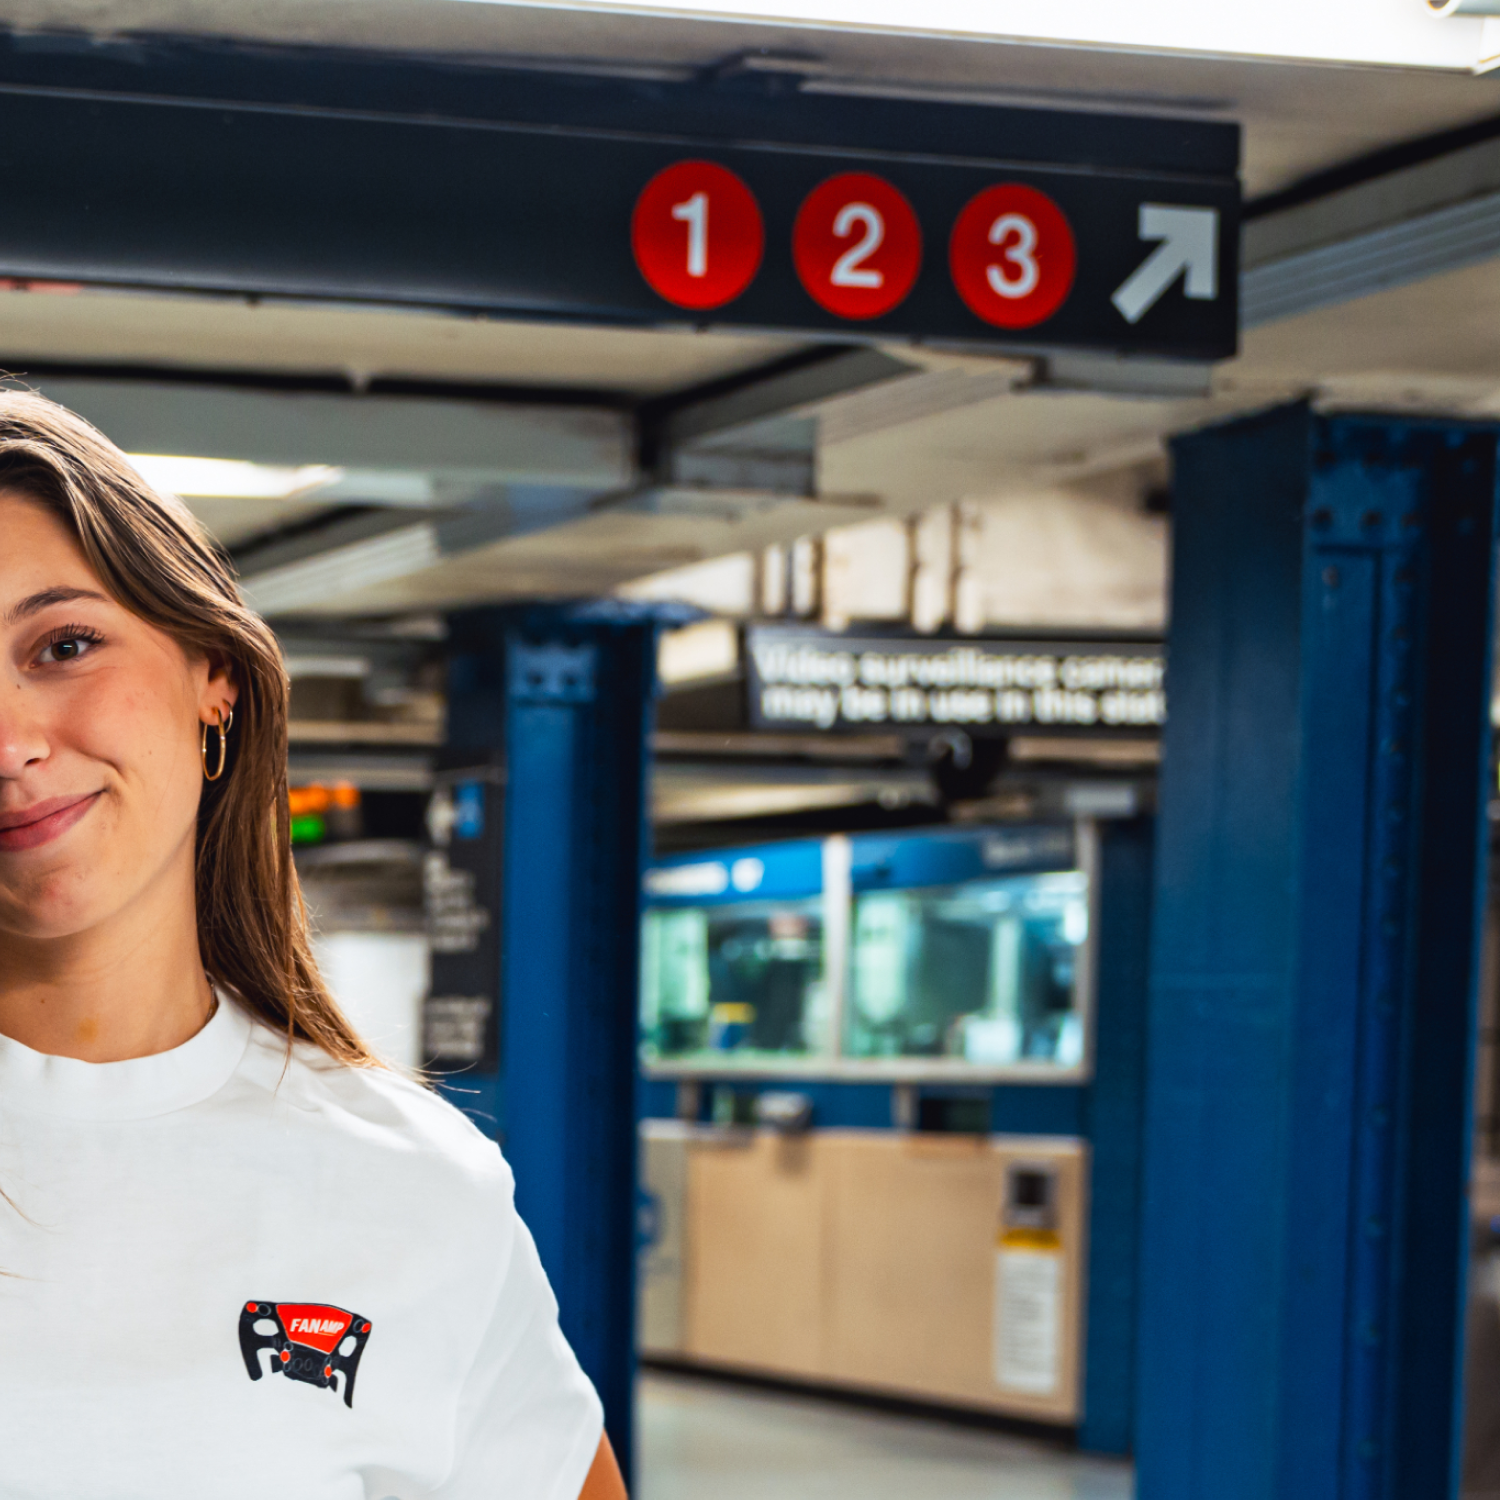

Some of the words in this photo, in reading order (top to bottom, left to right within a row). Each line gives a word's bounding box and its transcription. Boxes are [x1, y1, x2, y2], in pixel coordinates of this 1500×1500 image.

[672, 192, 709, 278] 1
[829, 202, 884, 289] 2
[986, 213, 1039, 299] 3
[1061, 656, 1166, 690] camer
[762, 686, 837, 729] may
[890, 688, 927, 723] in
[995, 690, 1031, 723] in
[289, 1318, 345, 1334] FANAMP
